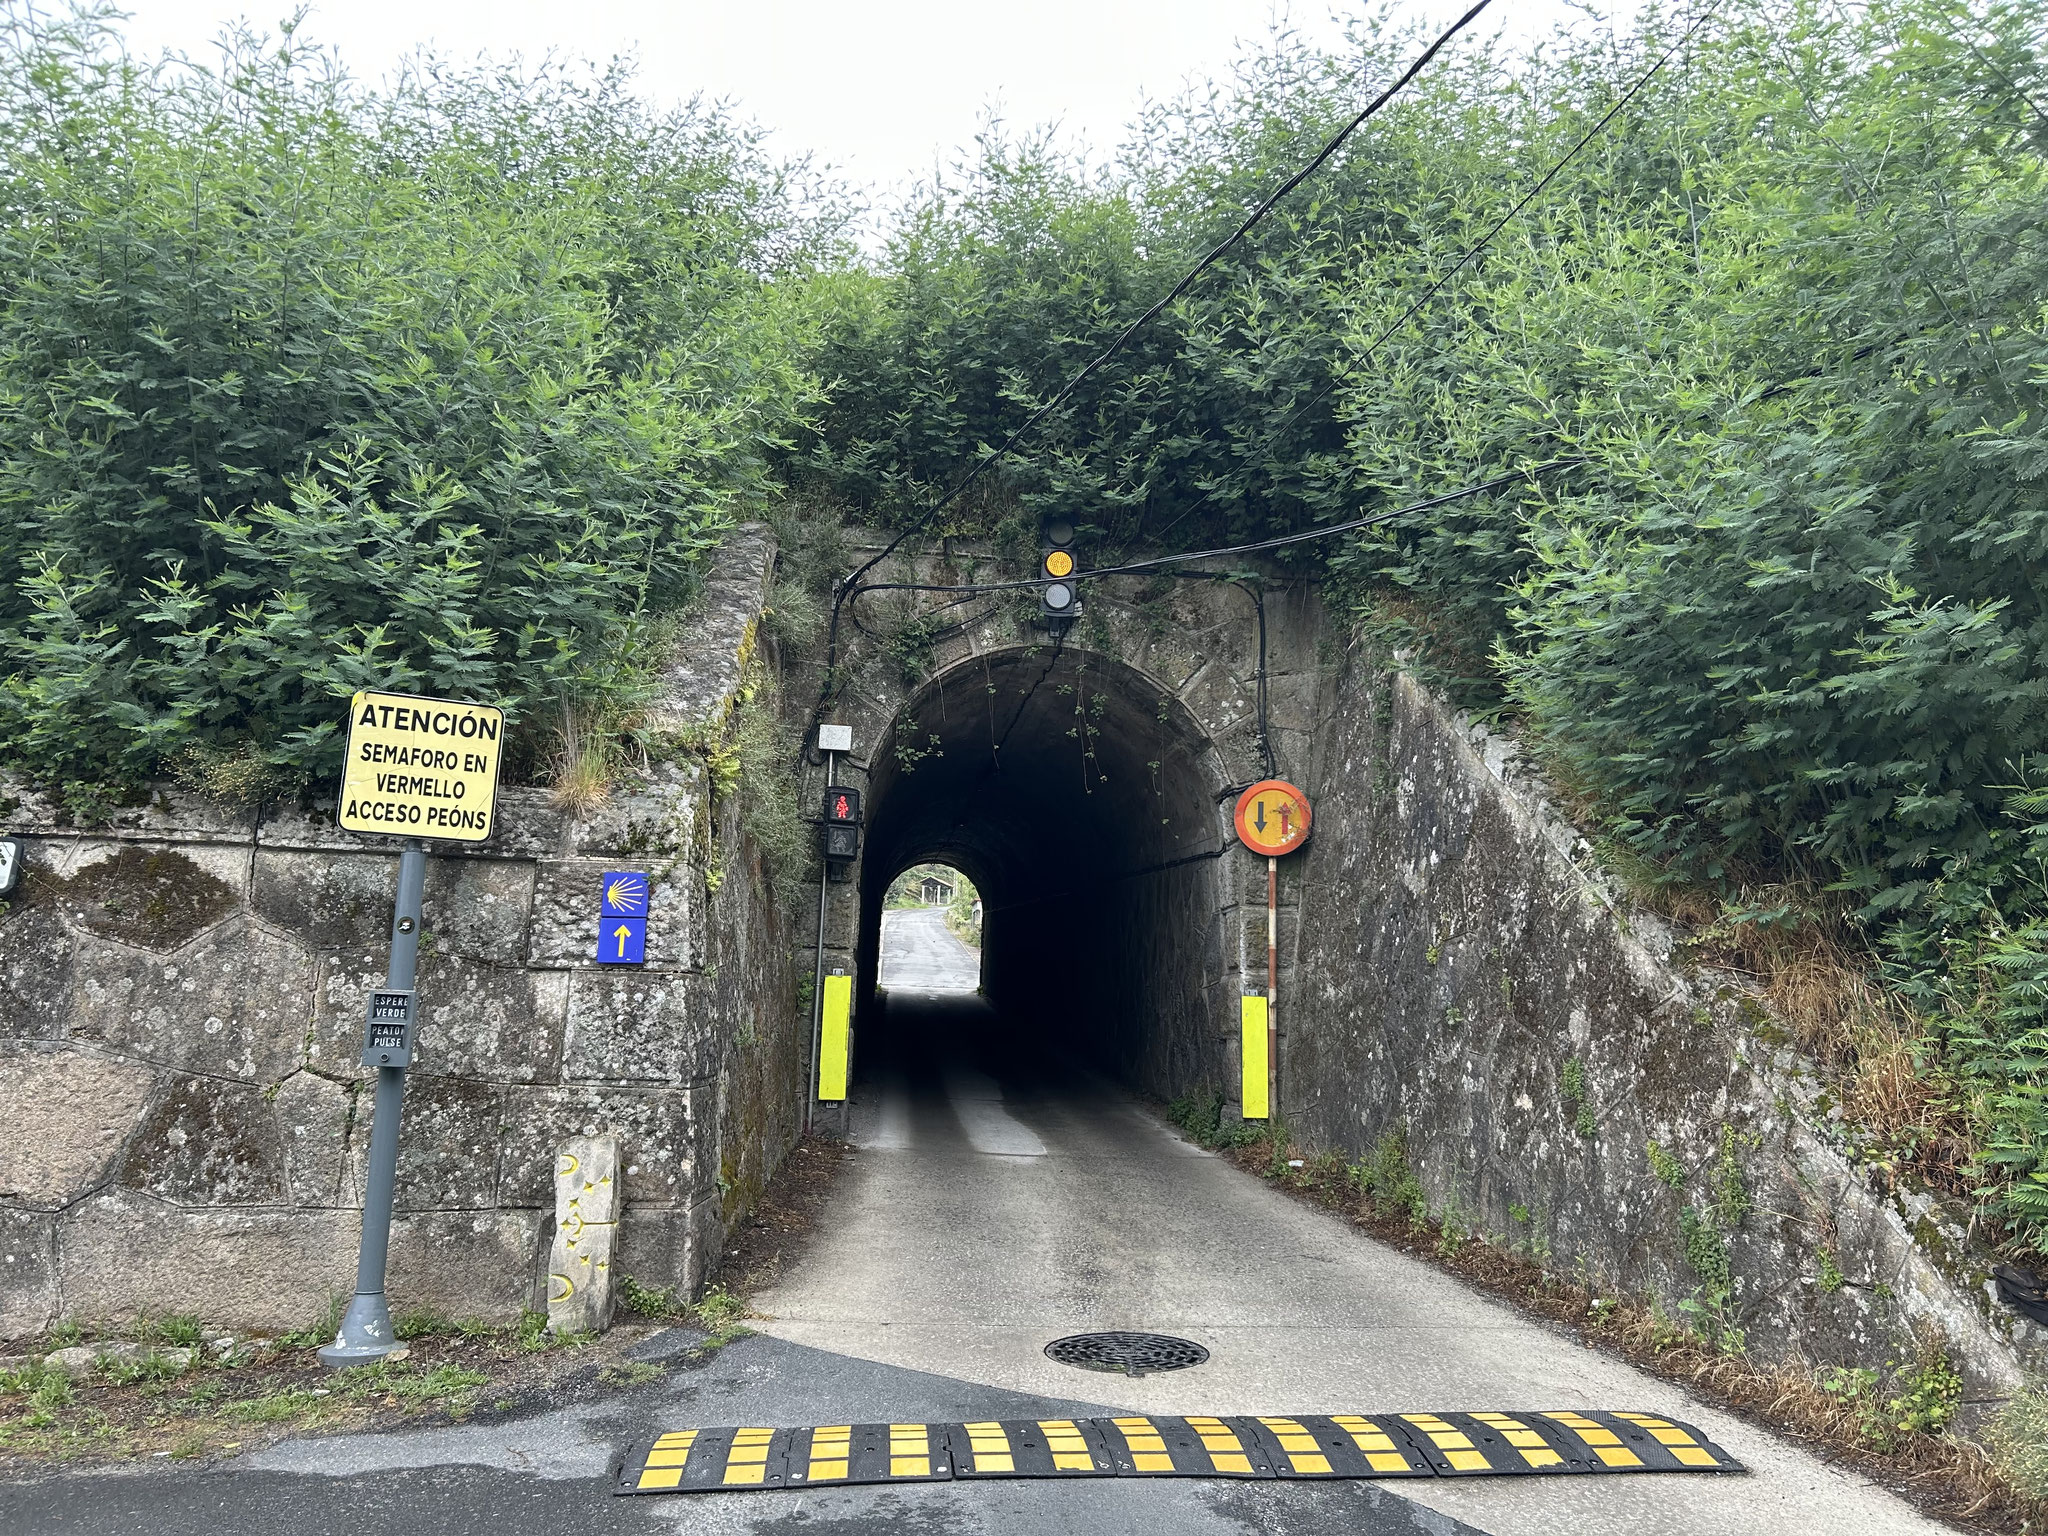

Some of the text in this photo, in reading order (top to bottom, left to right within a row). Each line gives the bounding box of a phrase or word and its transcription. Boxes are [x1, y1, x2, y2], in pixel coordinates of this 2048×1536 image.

[359, 704, 498, 740] ATENCIÓN
[360, 743, 487, 773] SEMAFORO EN
[377, 773, 465, 799] VERMELLO
[346, 800, 486, 830] ACCESO PEÓNS
[375, 997, 408, 1006] ESPERE
[376, 1008, 405, 1017] VERDE
[375, 1037, 401, 1047] PULSE
